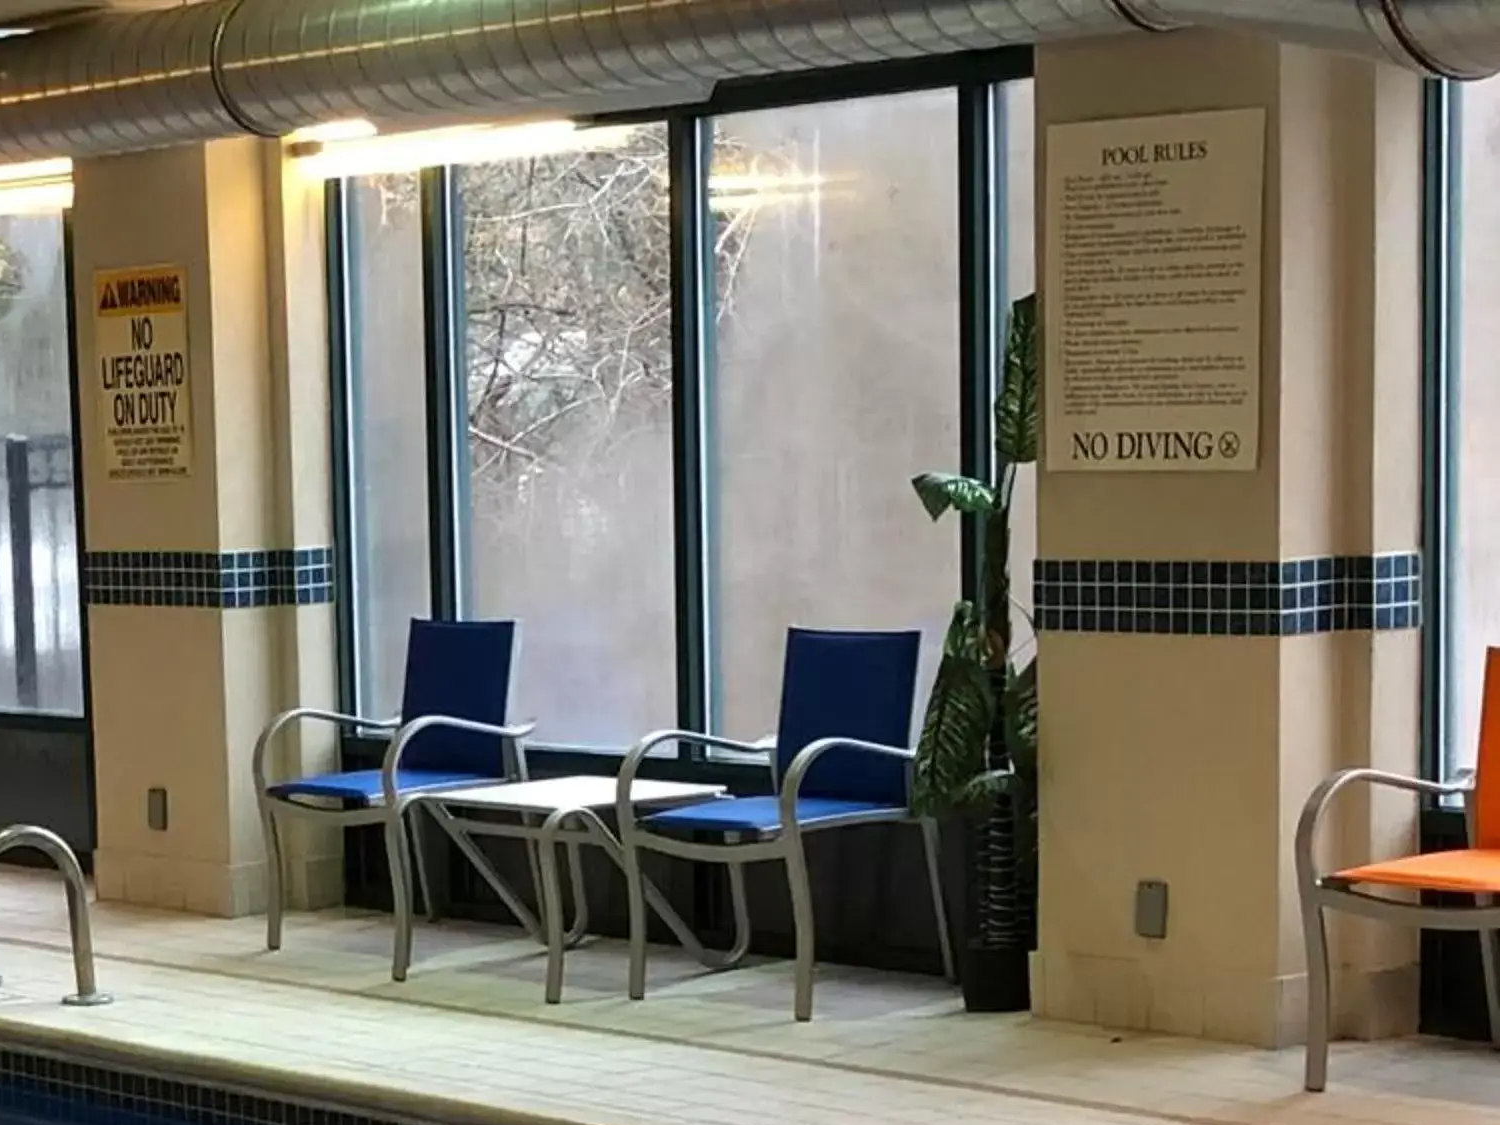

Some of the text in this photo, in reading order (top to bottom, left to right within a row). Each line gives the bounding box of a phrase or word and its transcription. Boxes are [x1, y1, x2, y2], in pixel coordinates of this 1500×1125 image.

[1101, 140, 1208, 167] POOL RULES
[117, 276, 182, 308] WARNING
[131, 317, 153, 350] NO
[101, 352, 185, 390] LIFEGUARD
[113, 390, 178, 427] ON DUTY
[1072, 430, 1214, 461] NO DIVING
